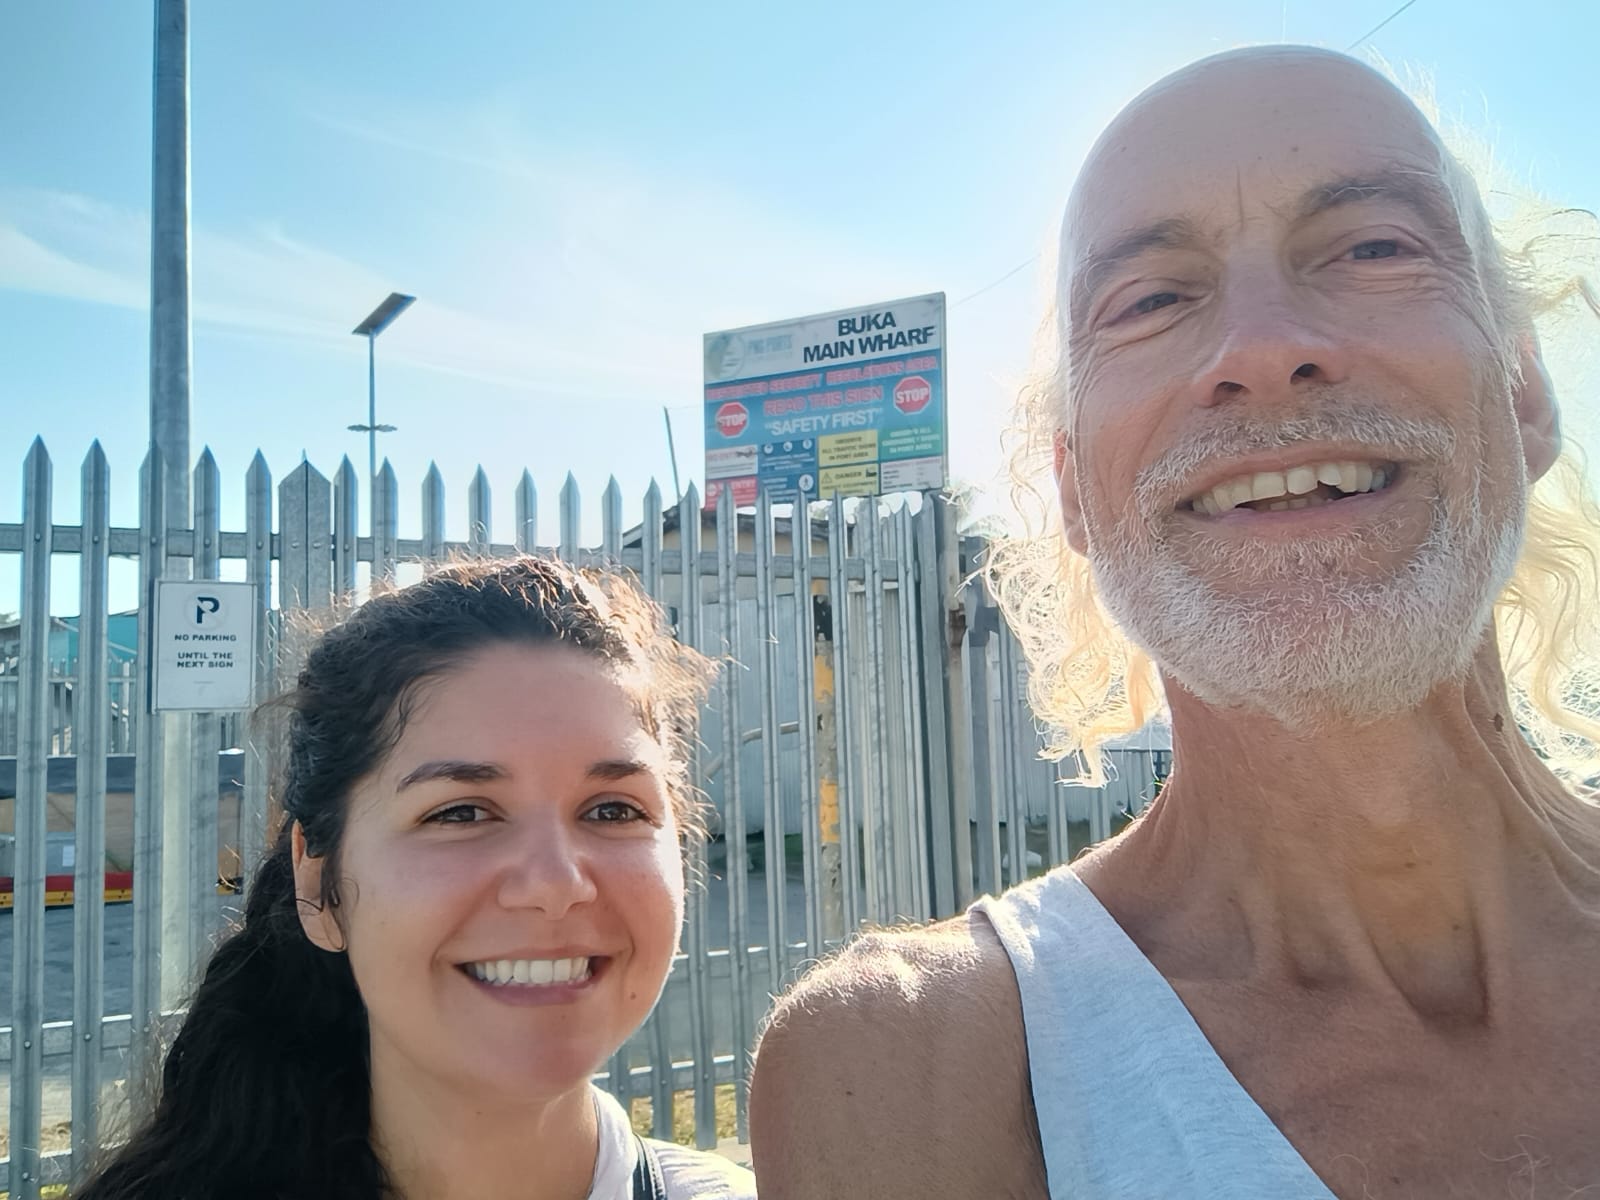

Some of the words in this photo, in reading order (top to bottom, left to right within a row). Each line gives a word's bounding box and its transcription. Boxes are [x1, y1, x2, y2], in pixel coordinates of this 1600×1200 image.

[838, 311, 896, 337] BUKA
[803, 339, 855, 363] MAIN
[859, 326, 936, 353] WHARF
[764, 397, 806, 416] READ
[810, 391, 842, 409] THIS
[845, 386, 883, 404] SIGN
[895, 387, 929, 404] STOP
[718, 413, 747, 427] STOP
[174, 634, 189, 642] NO
[192, 634, 237, 642] PARKING
